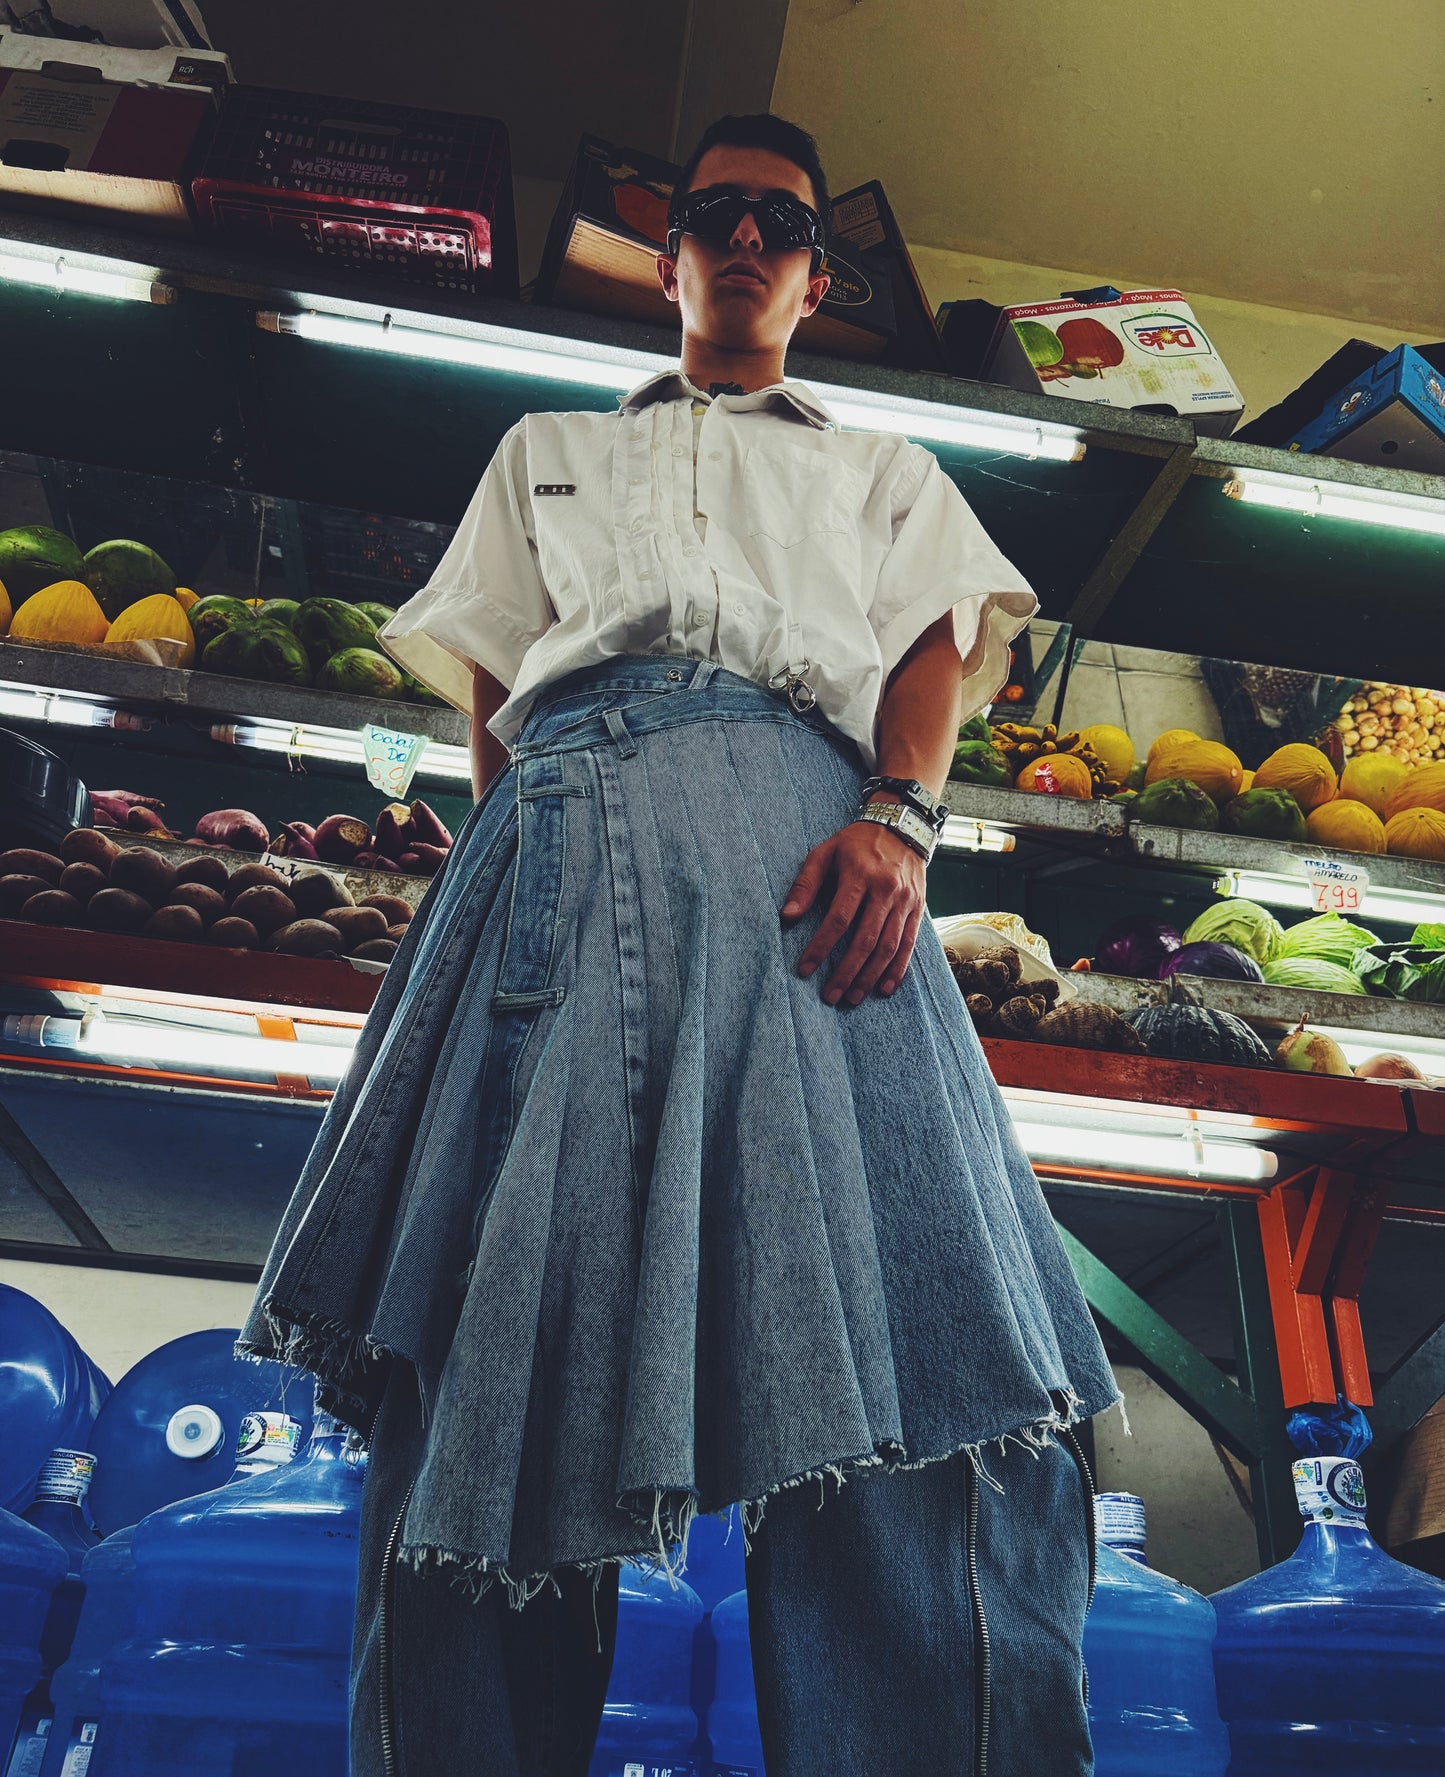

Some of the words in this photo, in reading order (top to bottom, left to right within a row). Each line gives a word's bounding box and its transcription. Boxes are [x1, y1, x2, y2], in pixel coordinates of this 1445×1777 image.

[290, 158, 409, 184] MONTEIRO
[315, 157, 390, 173] DISTRIBUIDORA
[1014, 307, 1038, 317] Maçã
[1137, 328, 1197, 351] Dole
[1314, 869, 1358, 882] AMARELO
[1312, 882, 1359, 910] 7,99
